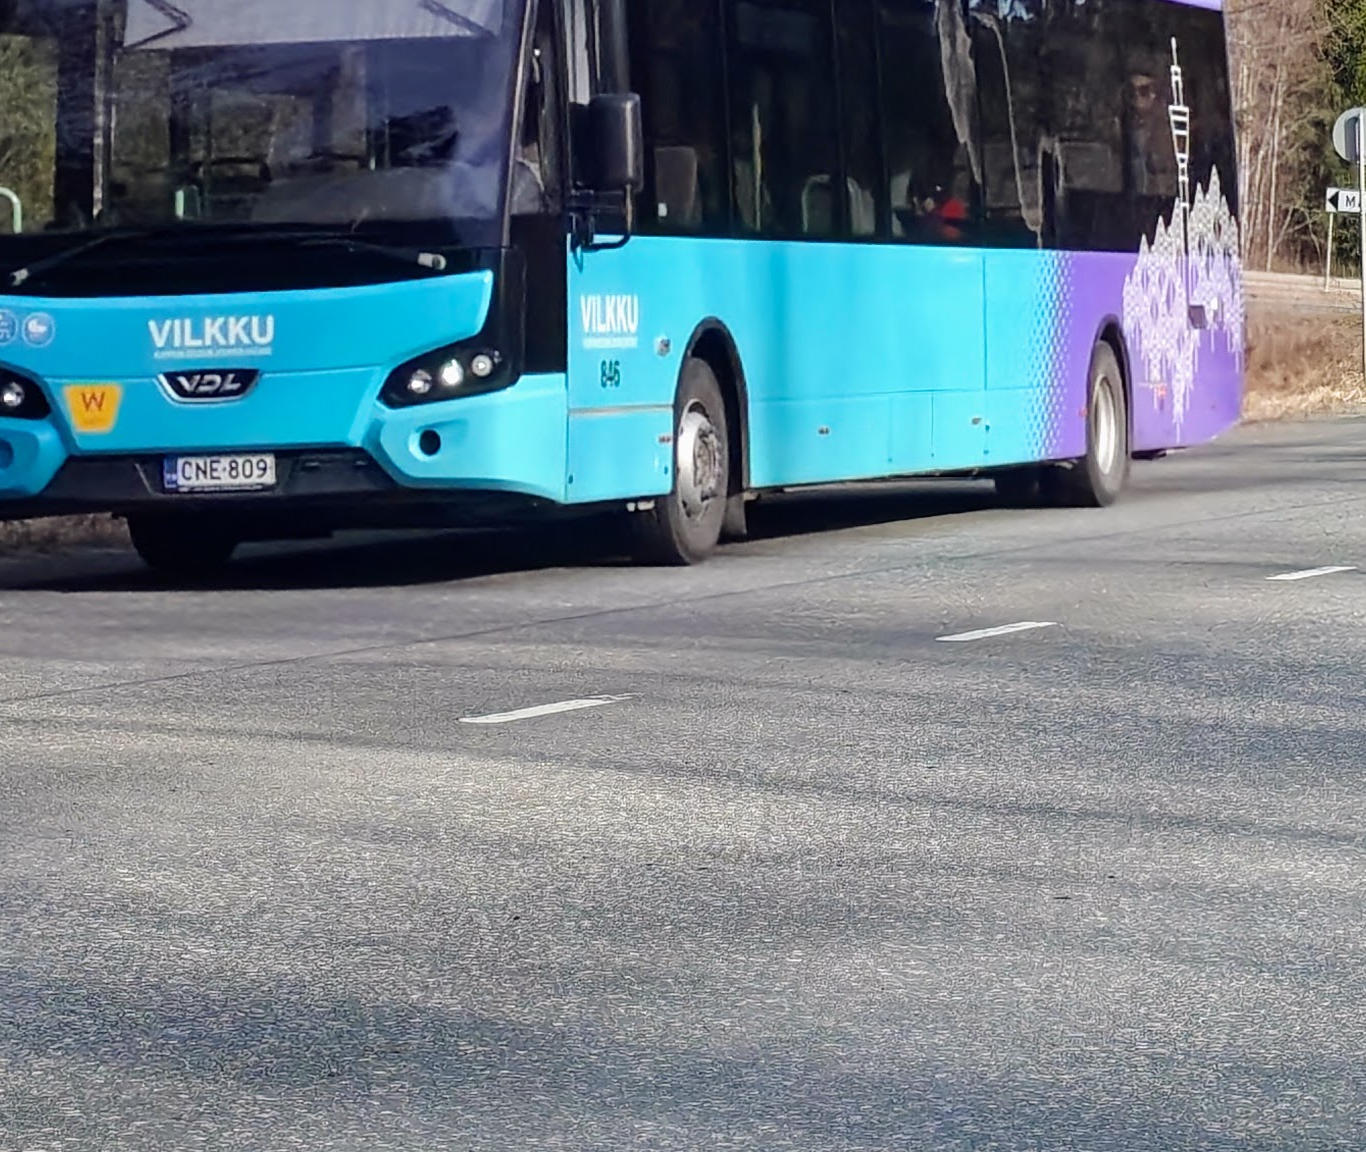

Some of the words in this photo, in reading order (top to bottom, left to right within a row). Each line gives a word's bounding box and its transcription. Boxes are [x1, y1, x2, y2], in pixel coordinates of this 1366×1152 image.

[580, 295, 639, 333] VILKKU
[148, 315, 274, 347] VILKKU
[177, 374, 241, 392] VDL
[81, 392, 106, 412] W
